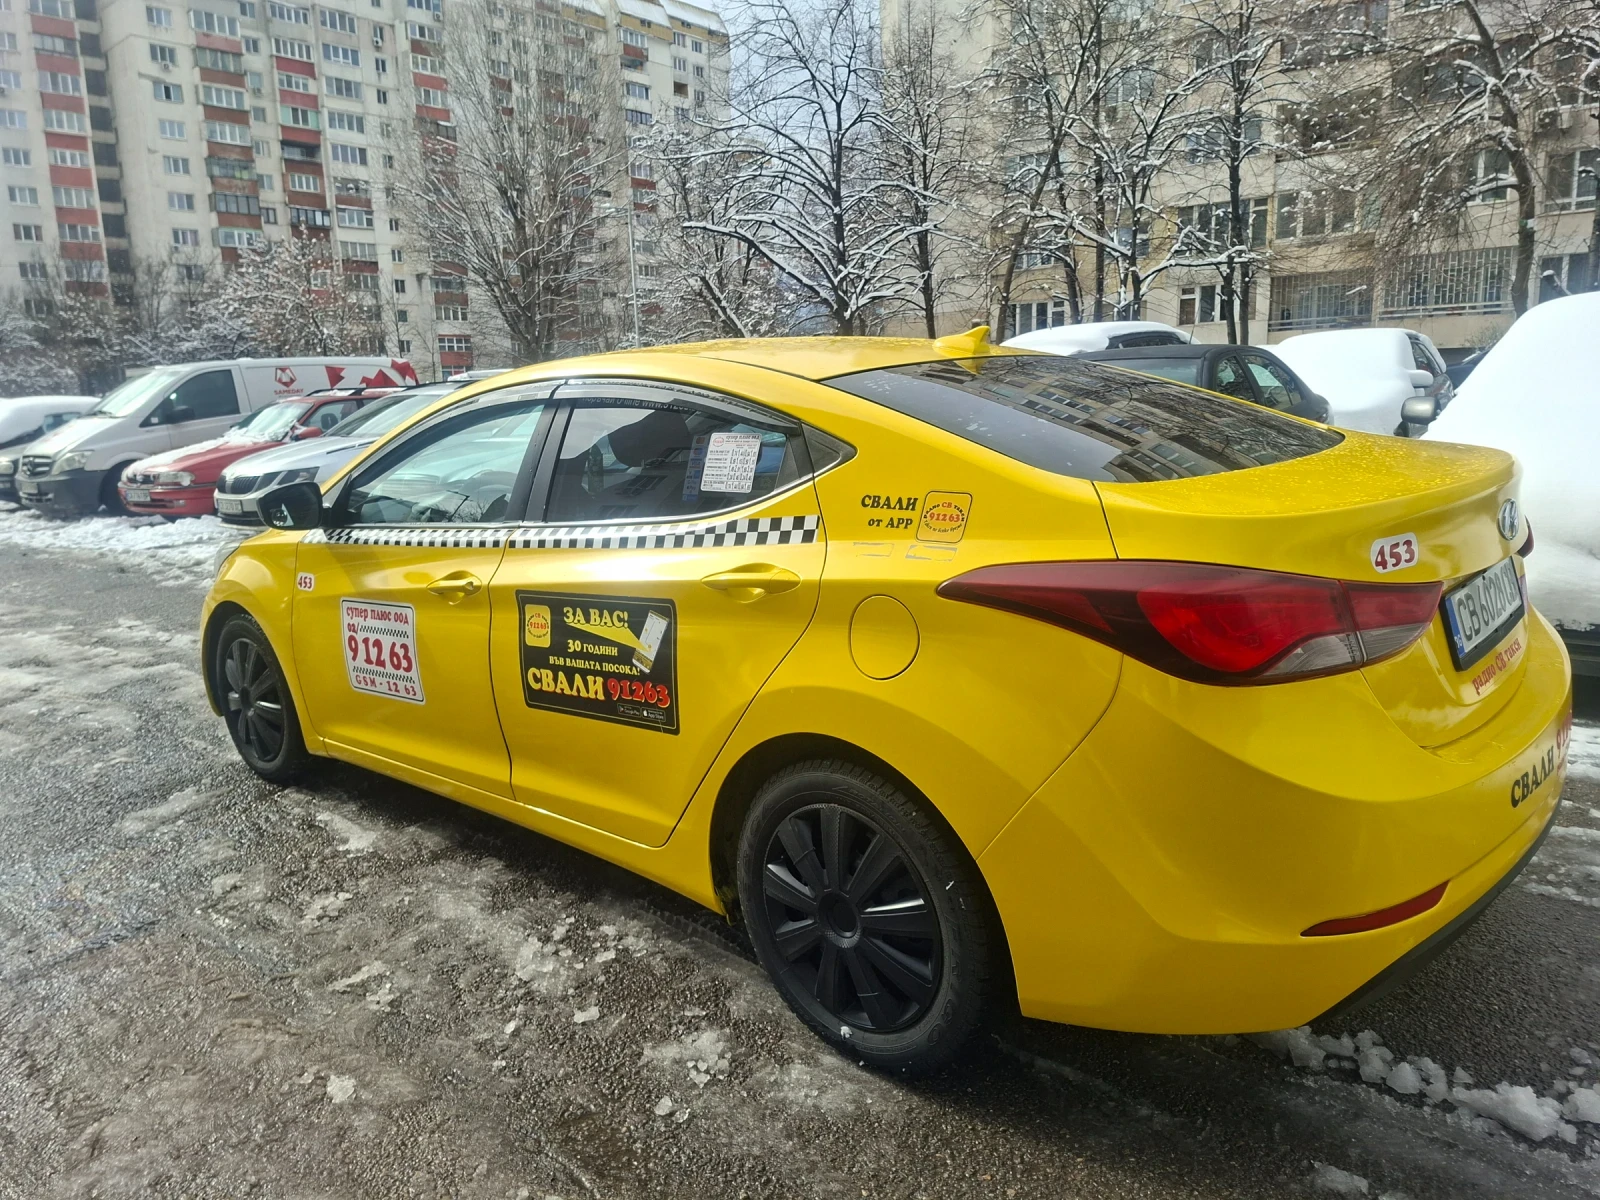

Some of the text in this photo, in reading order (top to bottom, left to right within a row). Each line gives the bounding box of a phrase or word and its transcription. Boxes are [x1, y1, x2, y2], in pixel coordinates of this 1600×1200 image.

[861, 495, 918, 511] СВАЛИ
[868, 518, 883, 527] от
[1375, 539, 1415, 570] 453
[298, 576, 312, 589] 453
[563, 607, 586, 626] ЗА
[589, 608, 629, 629] ВАС!
[567, 639, 582, 652] 30
[549, 656, 640, 676] ВЪВ ВАШАТА ПОСОКА!
[356, 674, 377, 688] GSM
[528, 667, 670, 708] СВАЛИ 91263
[1472, 664, 1496, 696] радио
[1511, 746, 1554, 808] СВАЛИ
